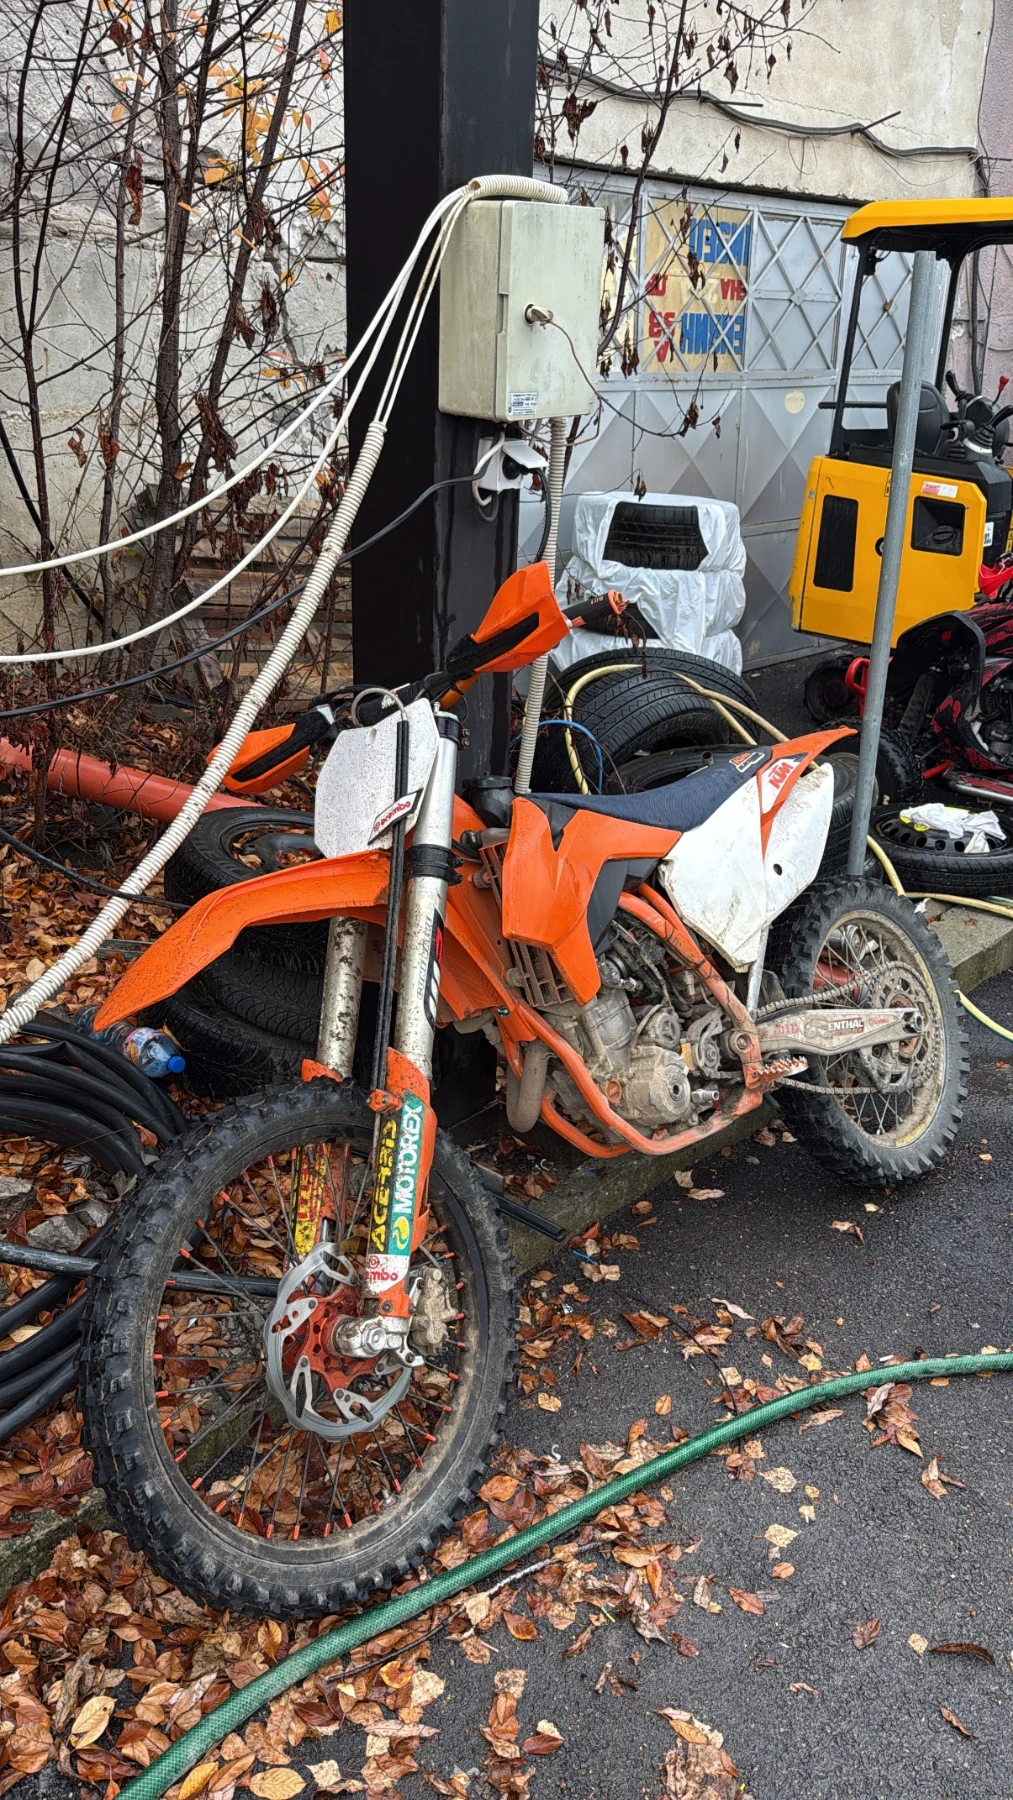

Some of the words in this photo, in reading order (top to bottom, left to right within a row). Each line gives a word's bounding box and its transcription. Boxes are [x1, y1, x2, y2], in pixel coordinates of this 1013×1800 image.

[680, 313, 744, 355] ЕНЗИН
[768, 761, 794, 789] KTM
[827, 1018, 864, 1031] ENTHAL
[393, 1103, 425, 1214] MOTOREX
